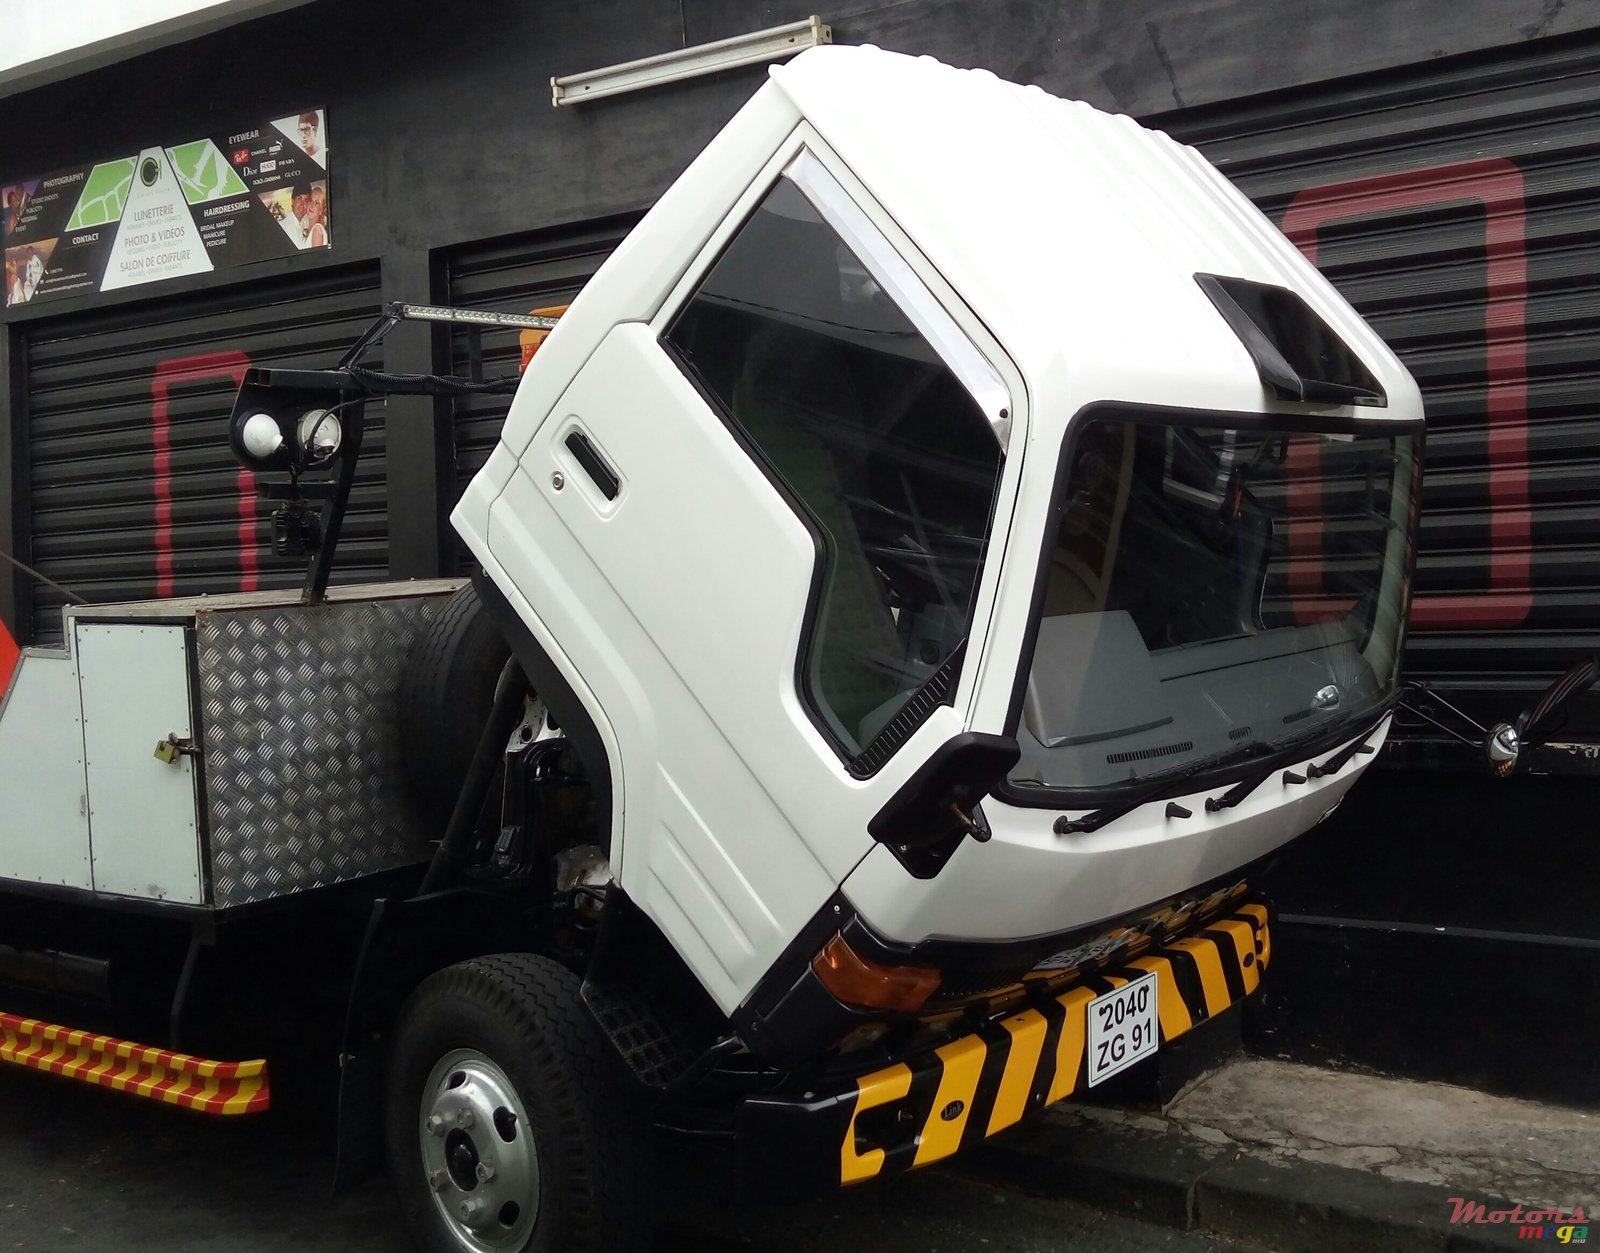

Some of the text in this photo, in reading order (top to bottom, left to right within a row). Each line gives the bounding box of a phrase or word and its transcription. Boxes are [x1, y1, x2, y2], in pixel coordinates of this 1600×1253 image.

[228, 130, 259, 144] EYEWEAR
[243, 166, 258, 177] Dior
[285, 170, 301, 178] GUCCI
[43, 172, 84, 189] PHOTOGRAPHY
[134, 204, 174, 221] LUNETTERIE
[203, 200, 250, 217] HAIRDRESSING
[200, 220, 235, 231] BRIDAL MAKEUP
[72, 233, 99, 245] CONTACT
[124, 233, 149, 248] PHOTO
[151, 232, 157, 242] &
[158, 226, 185, 241] VIDÉOS
[203, 230, 226, 239] MANICURE
[206, 238, 227, 247] PEDICURE
[120, 258, 144, 272] SALON
[146, 256, 155, 267] DE
[156, 249, 191, 265] COIFFURE
[1102, 986, 1148, 1032] 2040
[1097, 1017, 1151, 1072] ZG 91
[944, 1102, 961, 1118] Link
